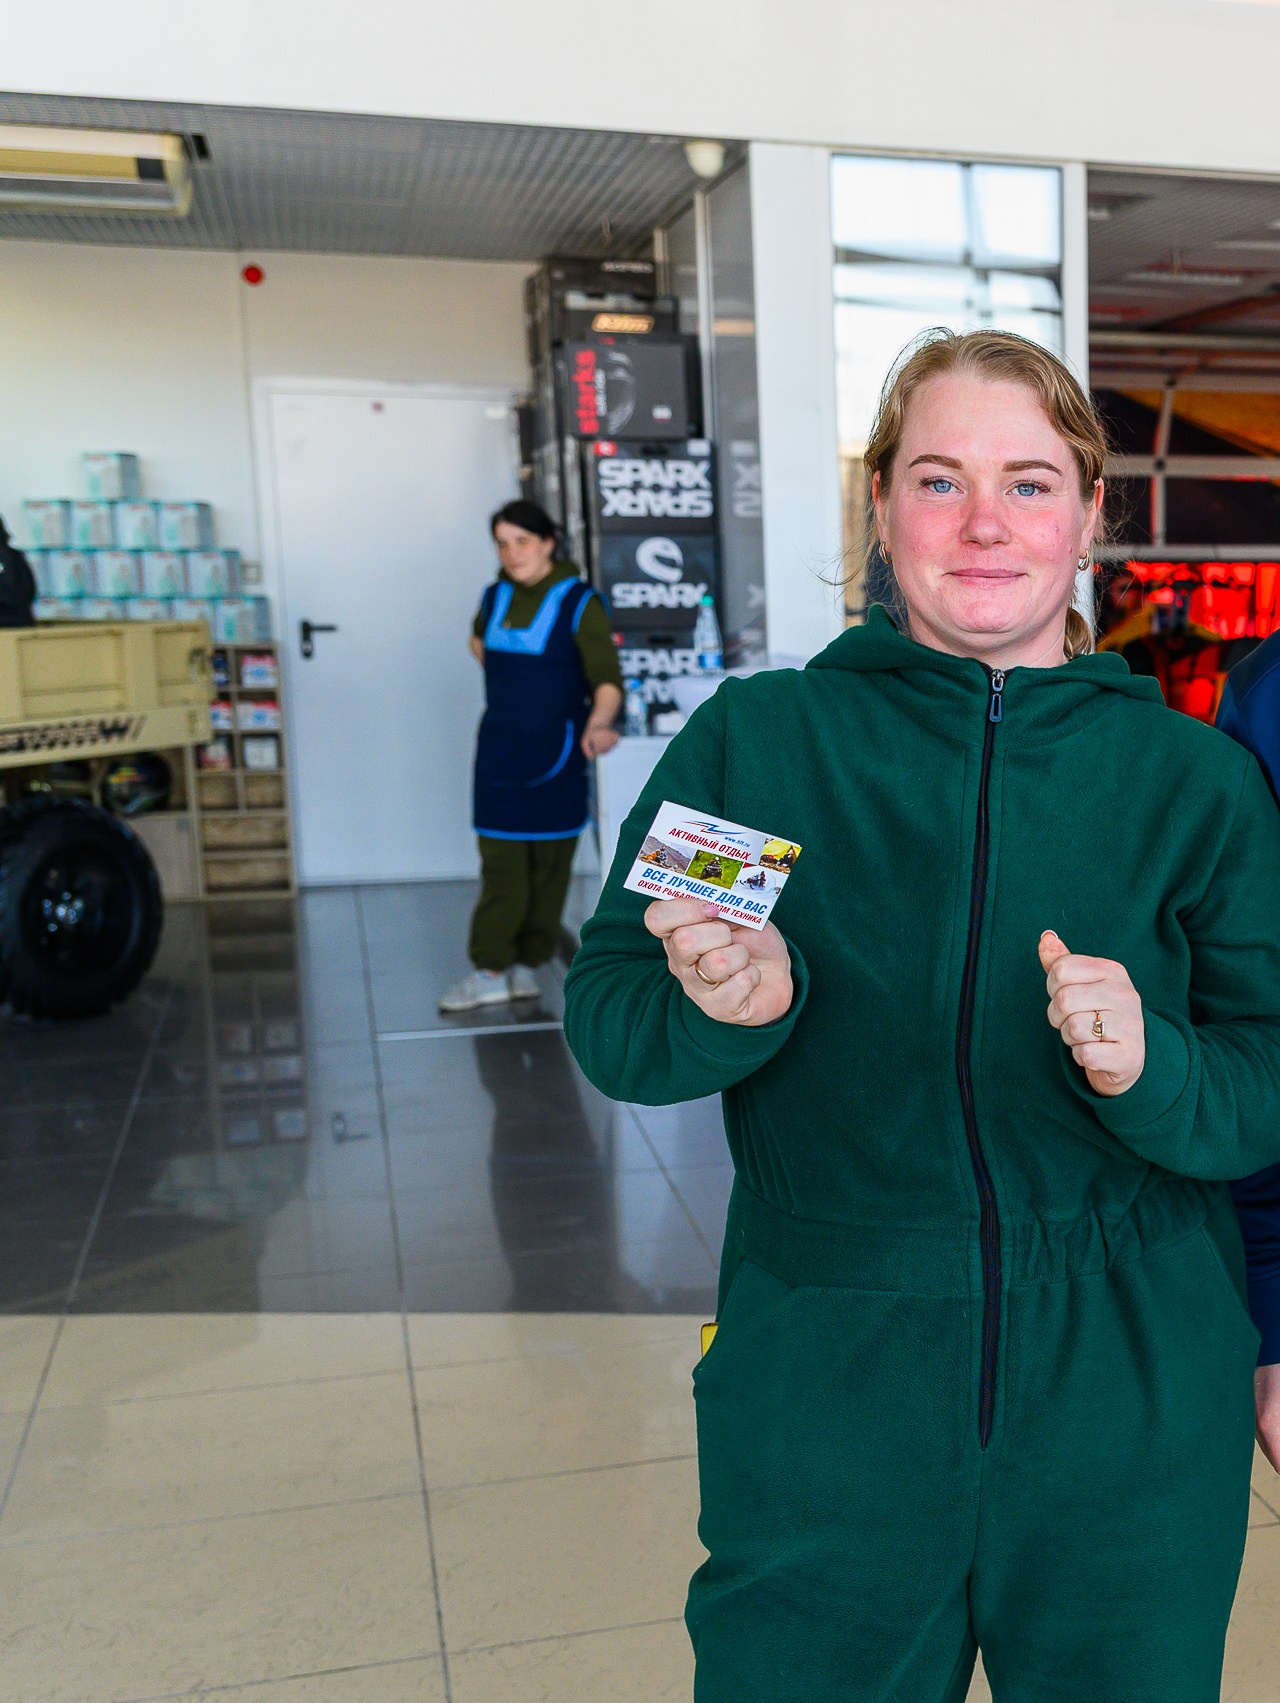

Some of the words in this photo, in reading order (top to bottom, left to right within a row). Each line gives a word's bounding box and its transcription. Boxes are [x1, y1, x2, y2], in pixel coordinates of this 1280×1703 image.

[598, 458, 712, 489] SPARX
[618, 648, 700, 677] SPAR
[668, 827, 720, 850] АКТИВНЫЙ
[718, 844, 752, 861] ОТДЫХ
[637, 879, 662, 894] ОХОТА
[730, 907, 763, 924] ТЕХНИКА
[641, 867, 669, 883] ВСЕ
[666, 876, 718, 899] ЛУЧШЕЕ
[716, 889, 744, 907] ДЛЯ
[742, 899, 768, 915] ВАС
